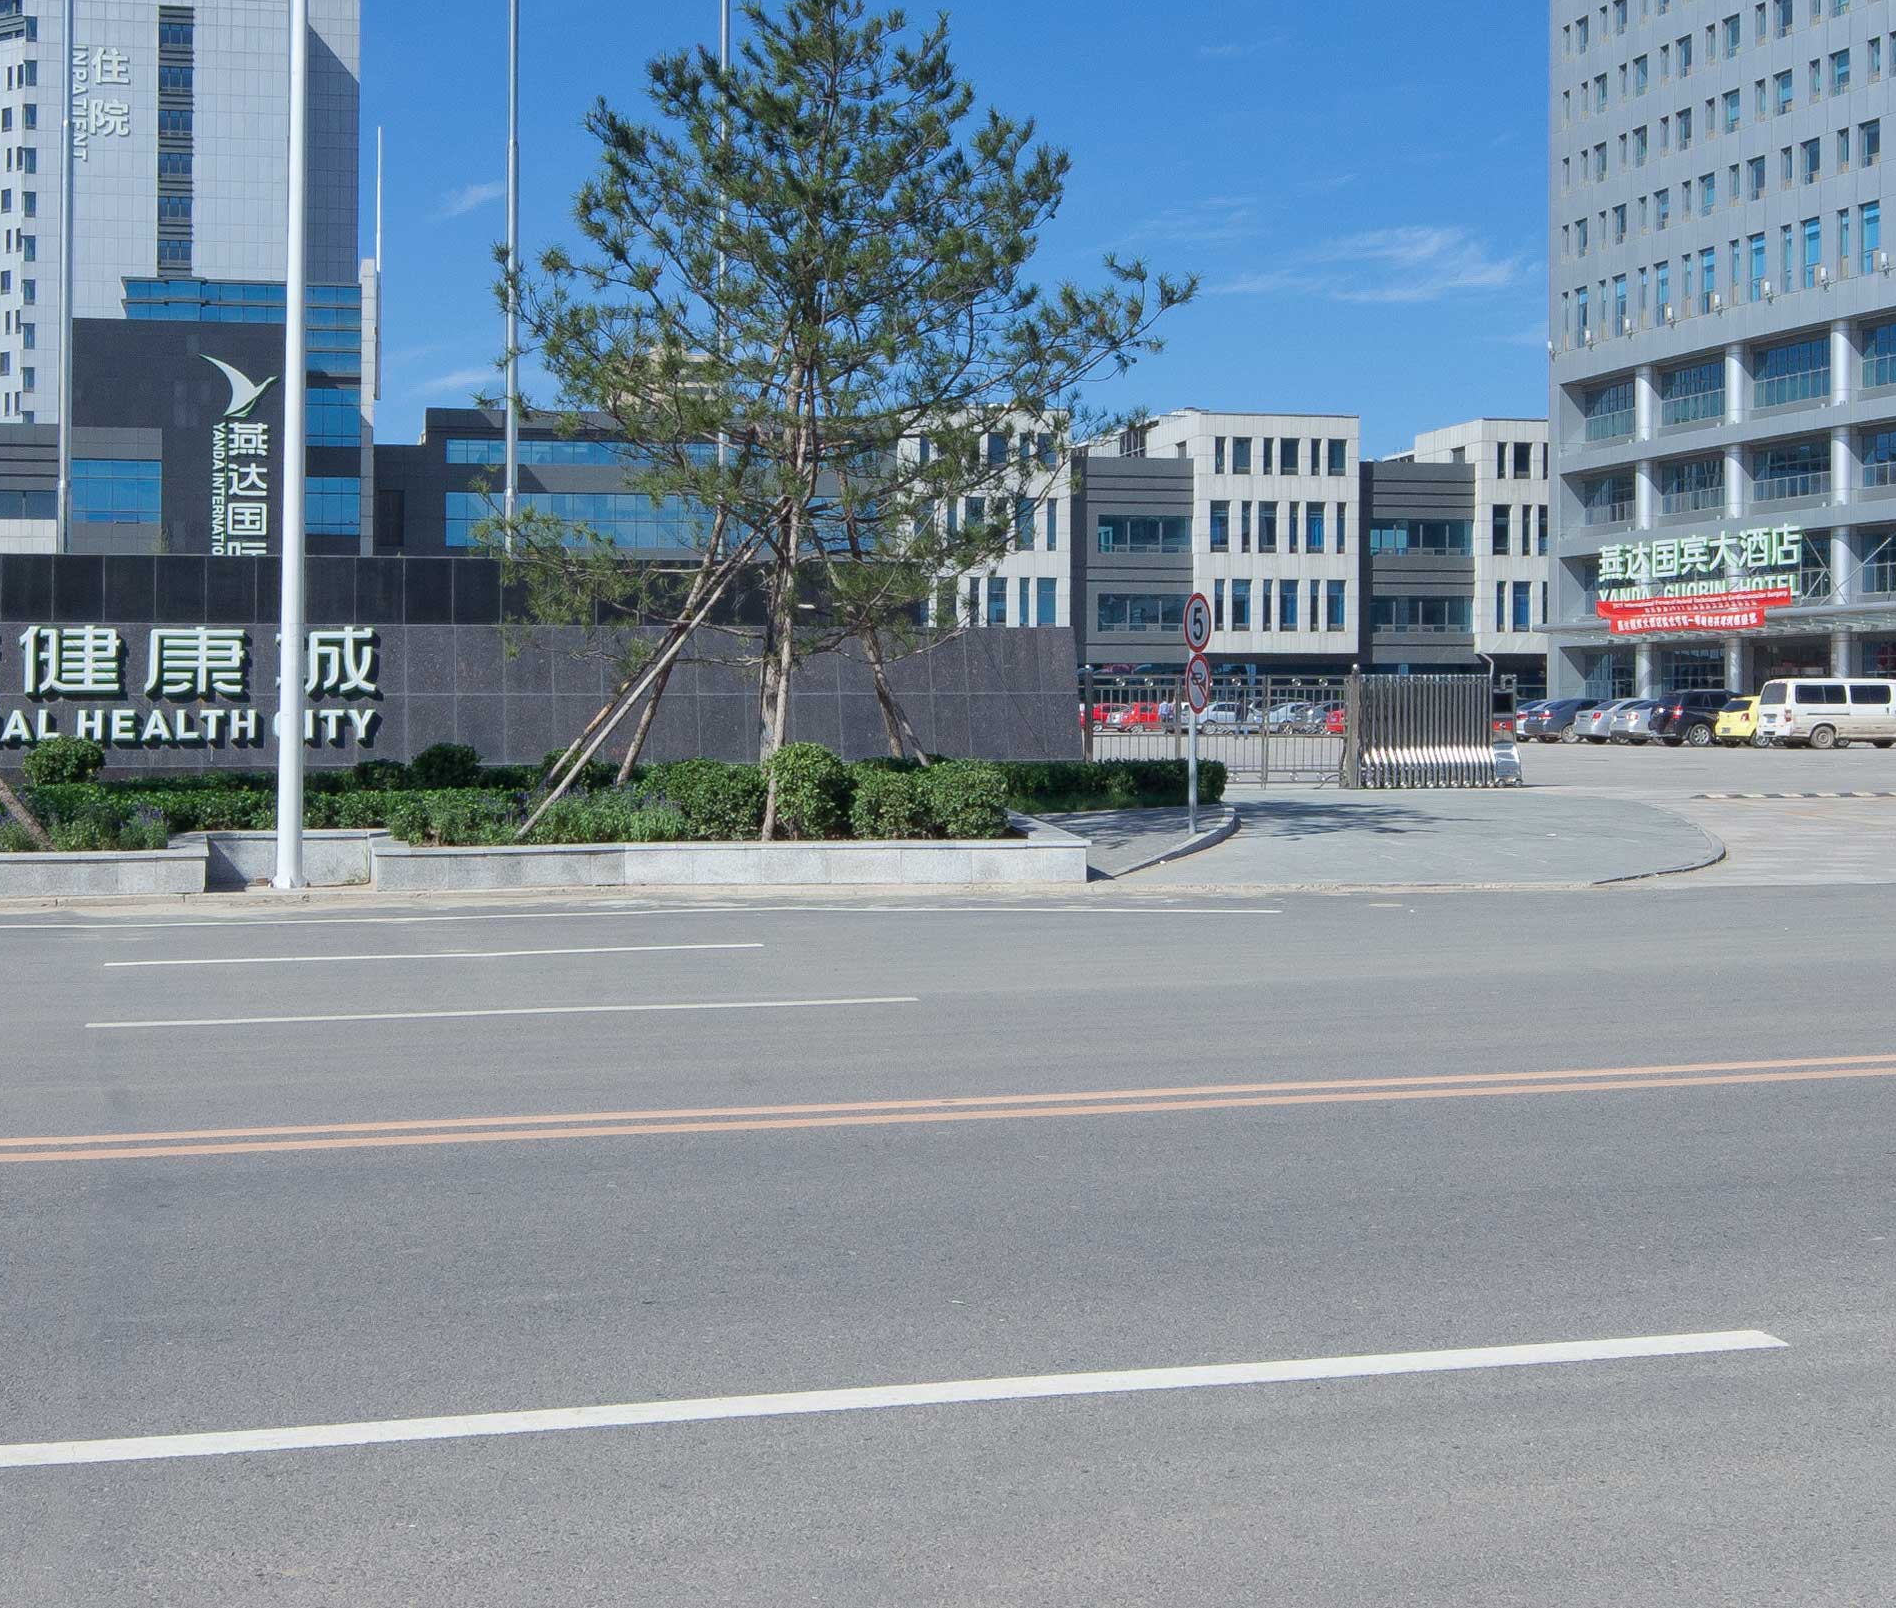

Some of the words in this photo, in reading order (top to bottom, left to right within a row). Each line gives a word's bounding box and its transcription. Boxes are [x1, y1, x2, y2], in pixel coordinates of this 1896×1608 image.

[72, 45, 89, 162] INPATIENT
[91, 46, 131, 137] 住院
[212, 422, 226, 470] YANDA
[211, 472, 226, 555] INTERNATIO
[1598, 523, 1802, 582] 燕达国宾大酒店
[1599, 586, 1650, 602] YANDA
[1740, 575, 1801, 596] HOTEL
[1193, 607, 1203, 641] 5
[77, 709, 257, 742] HEALTH
[273, 709, 377, 742] ITY
